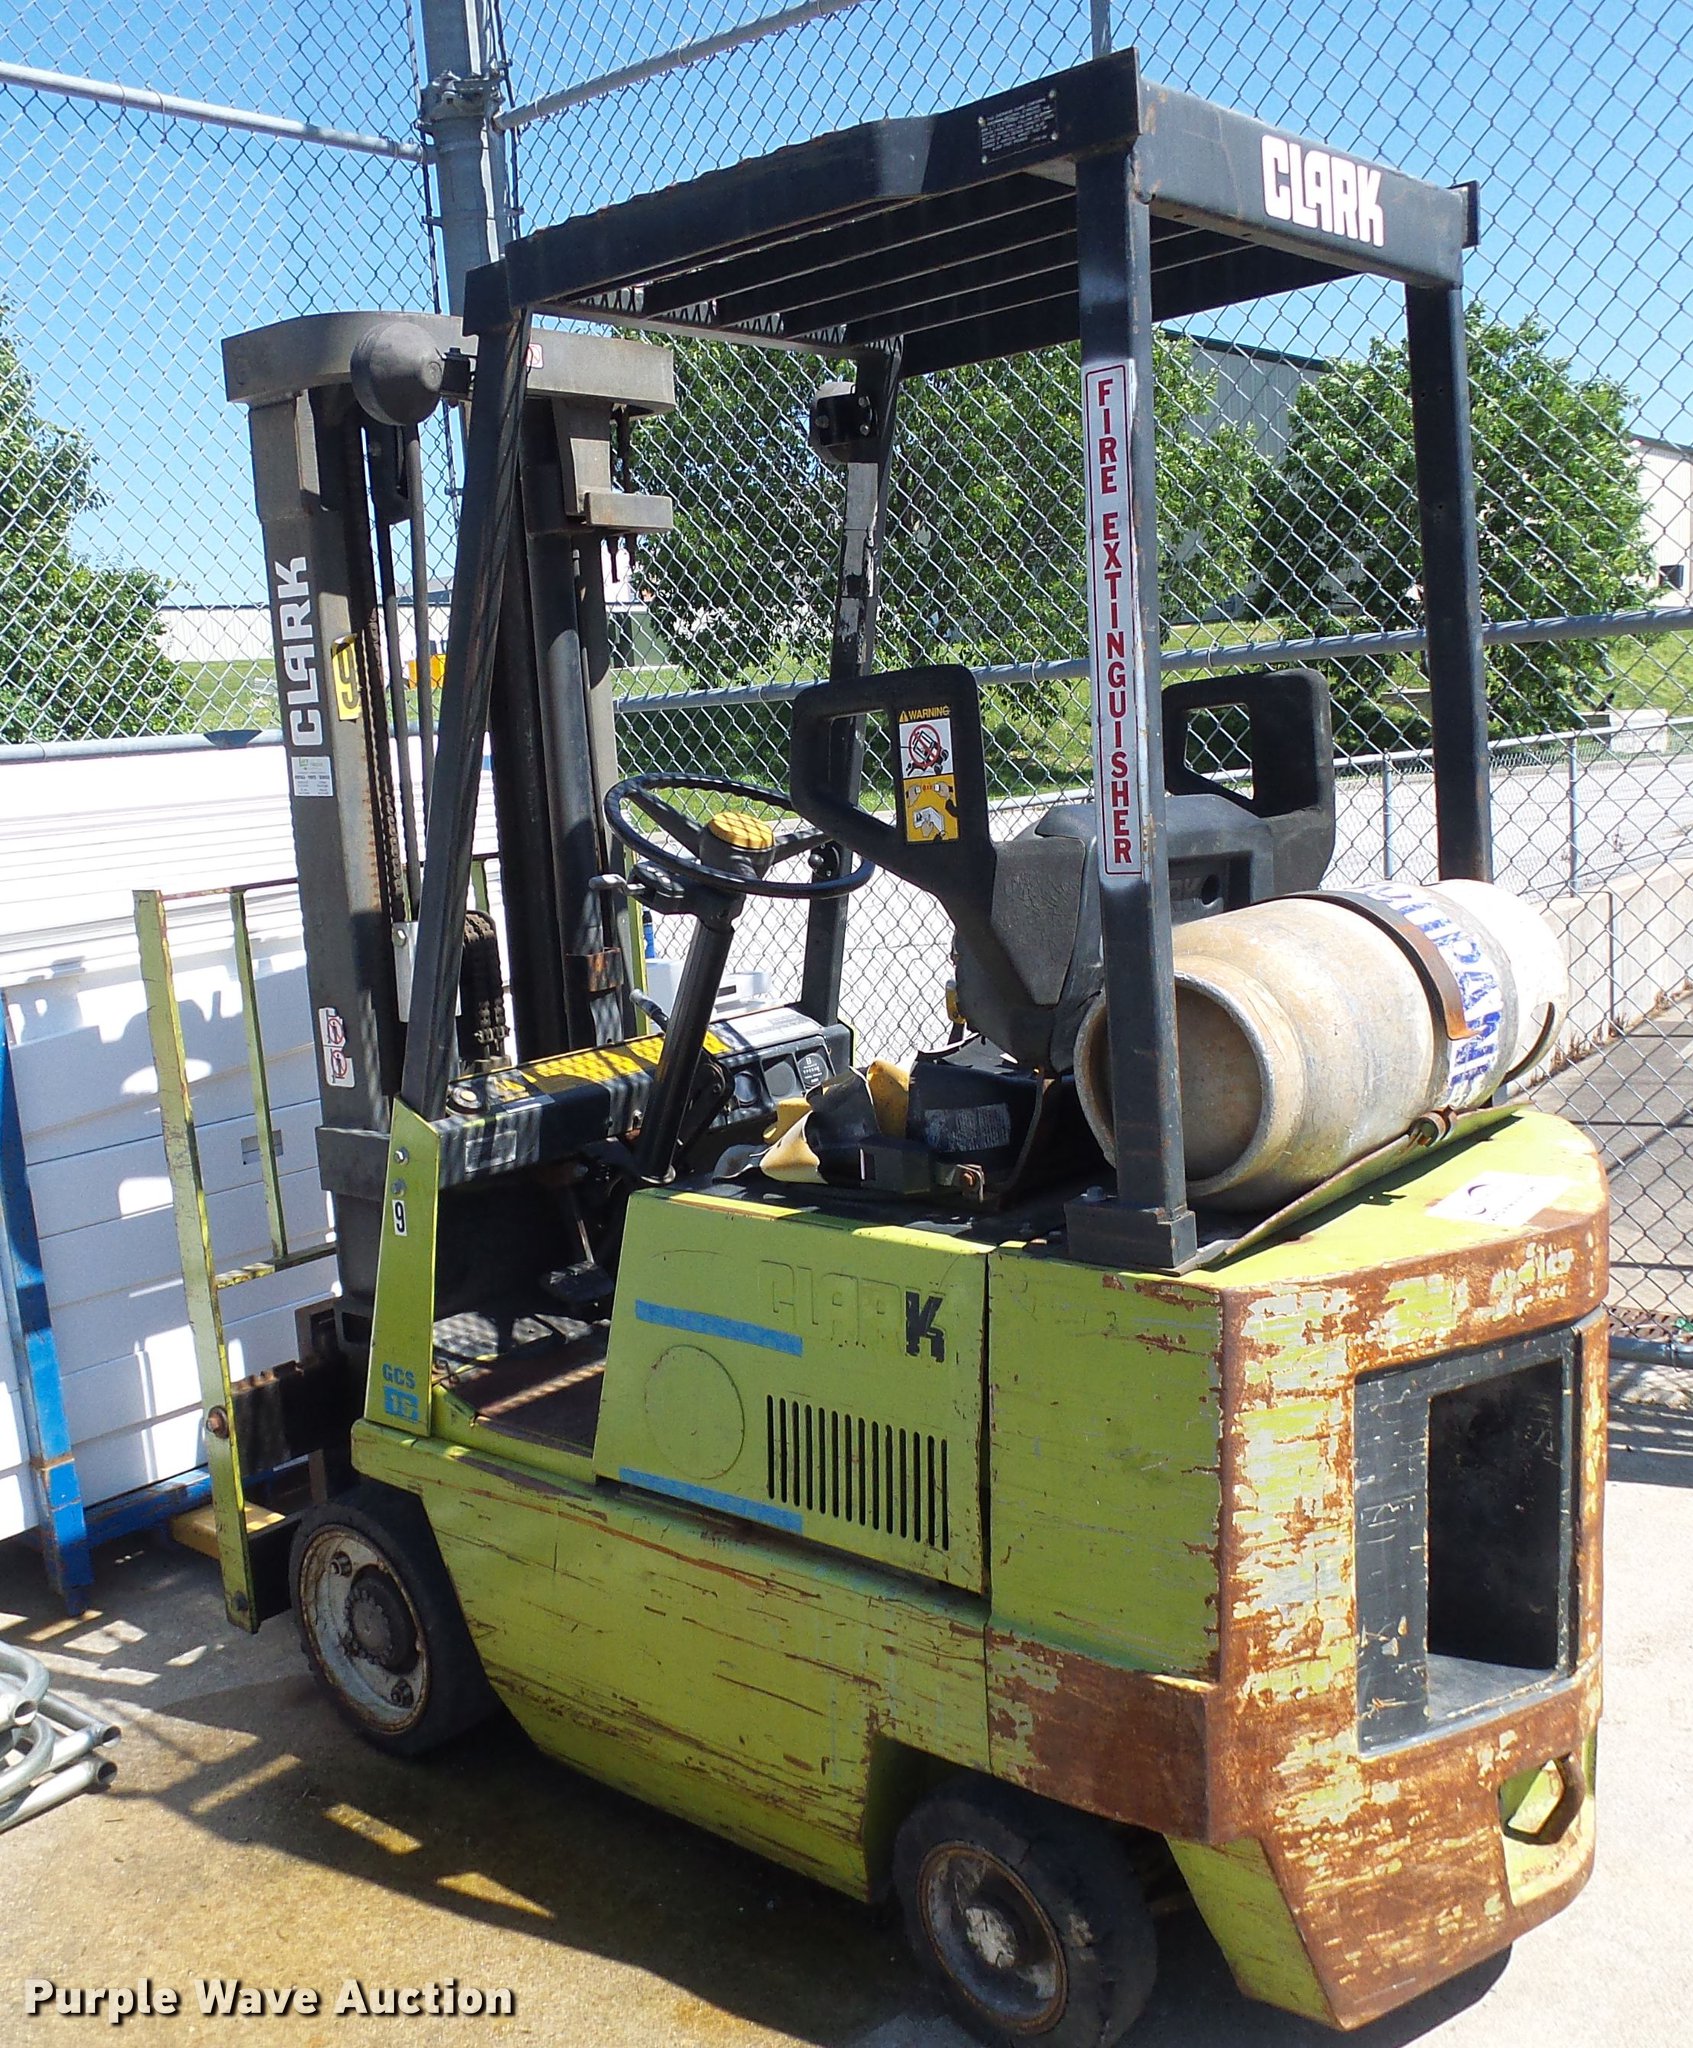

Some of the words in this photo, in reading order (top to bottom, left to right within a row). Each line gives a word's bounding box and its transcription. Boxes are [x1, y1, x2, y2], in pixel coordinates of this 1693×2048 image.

[1261, 134, 1384, 248] CLARK
[1097, 378, 1118, 495] FIRE
[274, 556, 323, 747] CLARK
[1102, 511, 1132, 864] EXTINGUISHER
[908, 705, 951, 720] WARNING
[394, 1201, 406, 1234] 9
[382, 1363, 416, 1389] GCS
